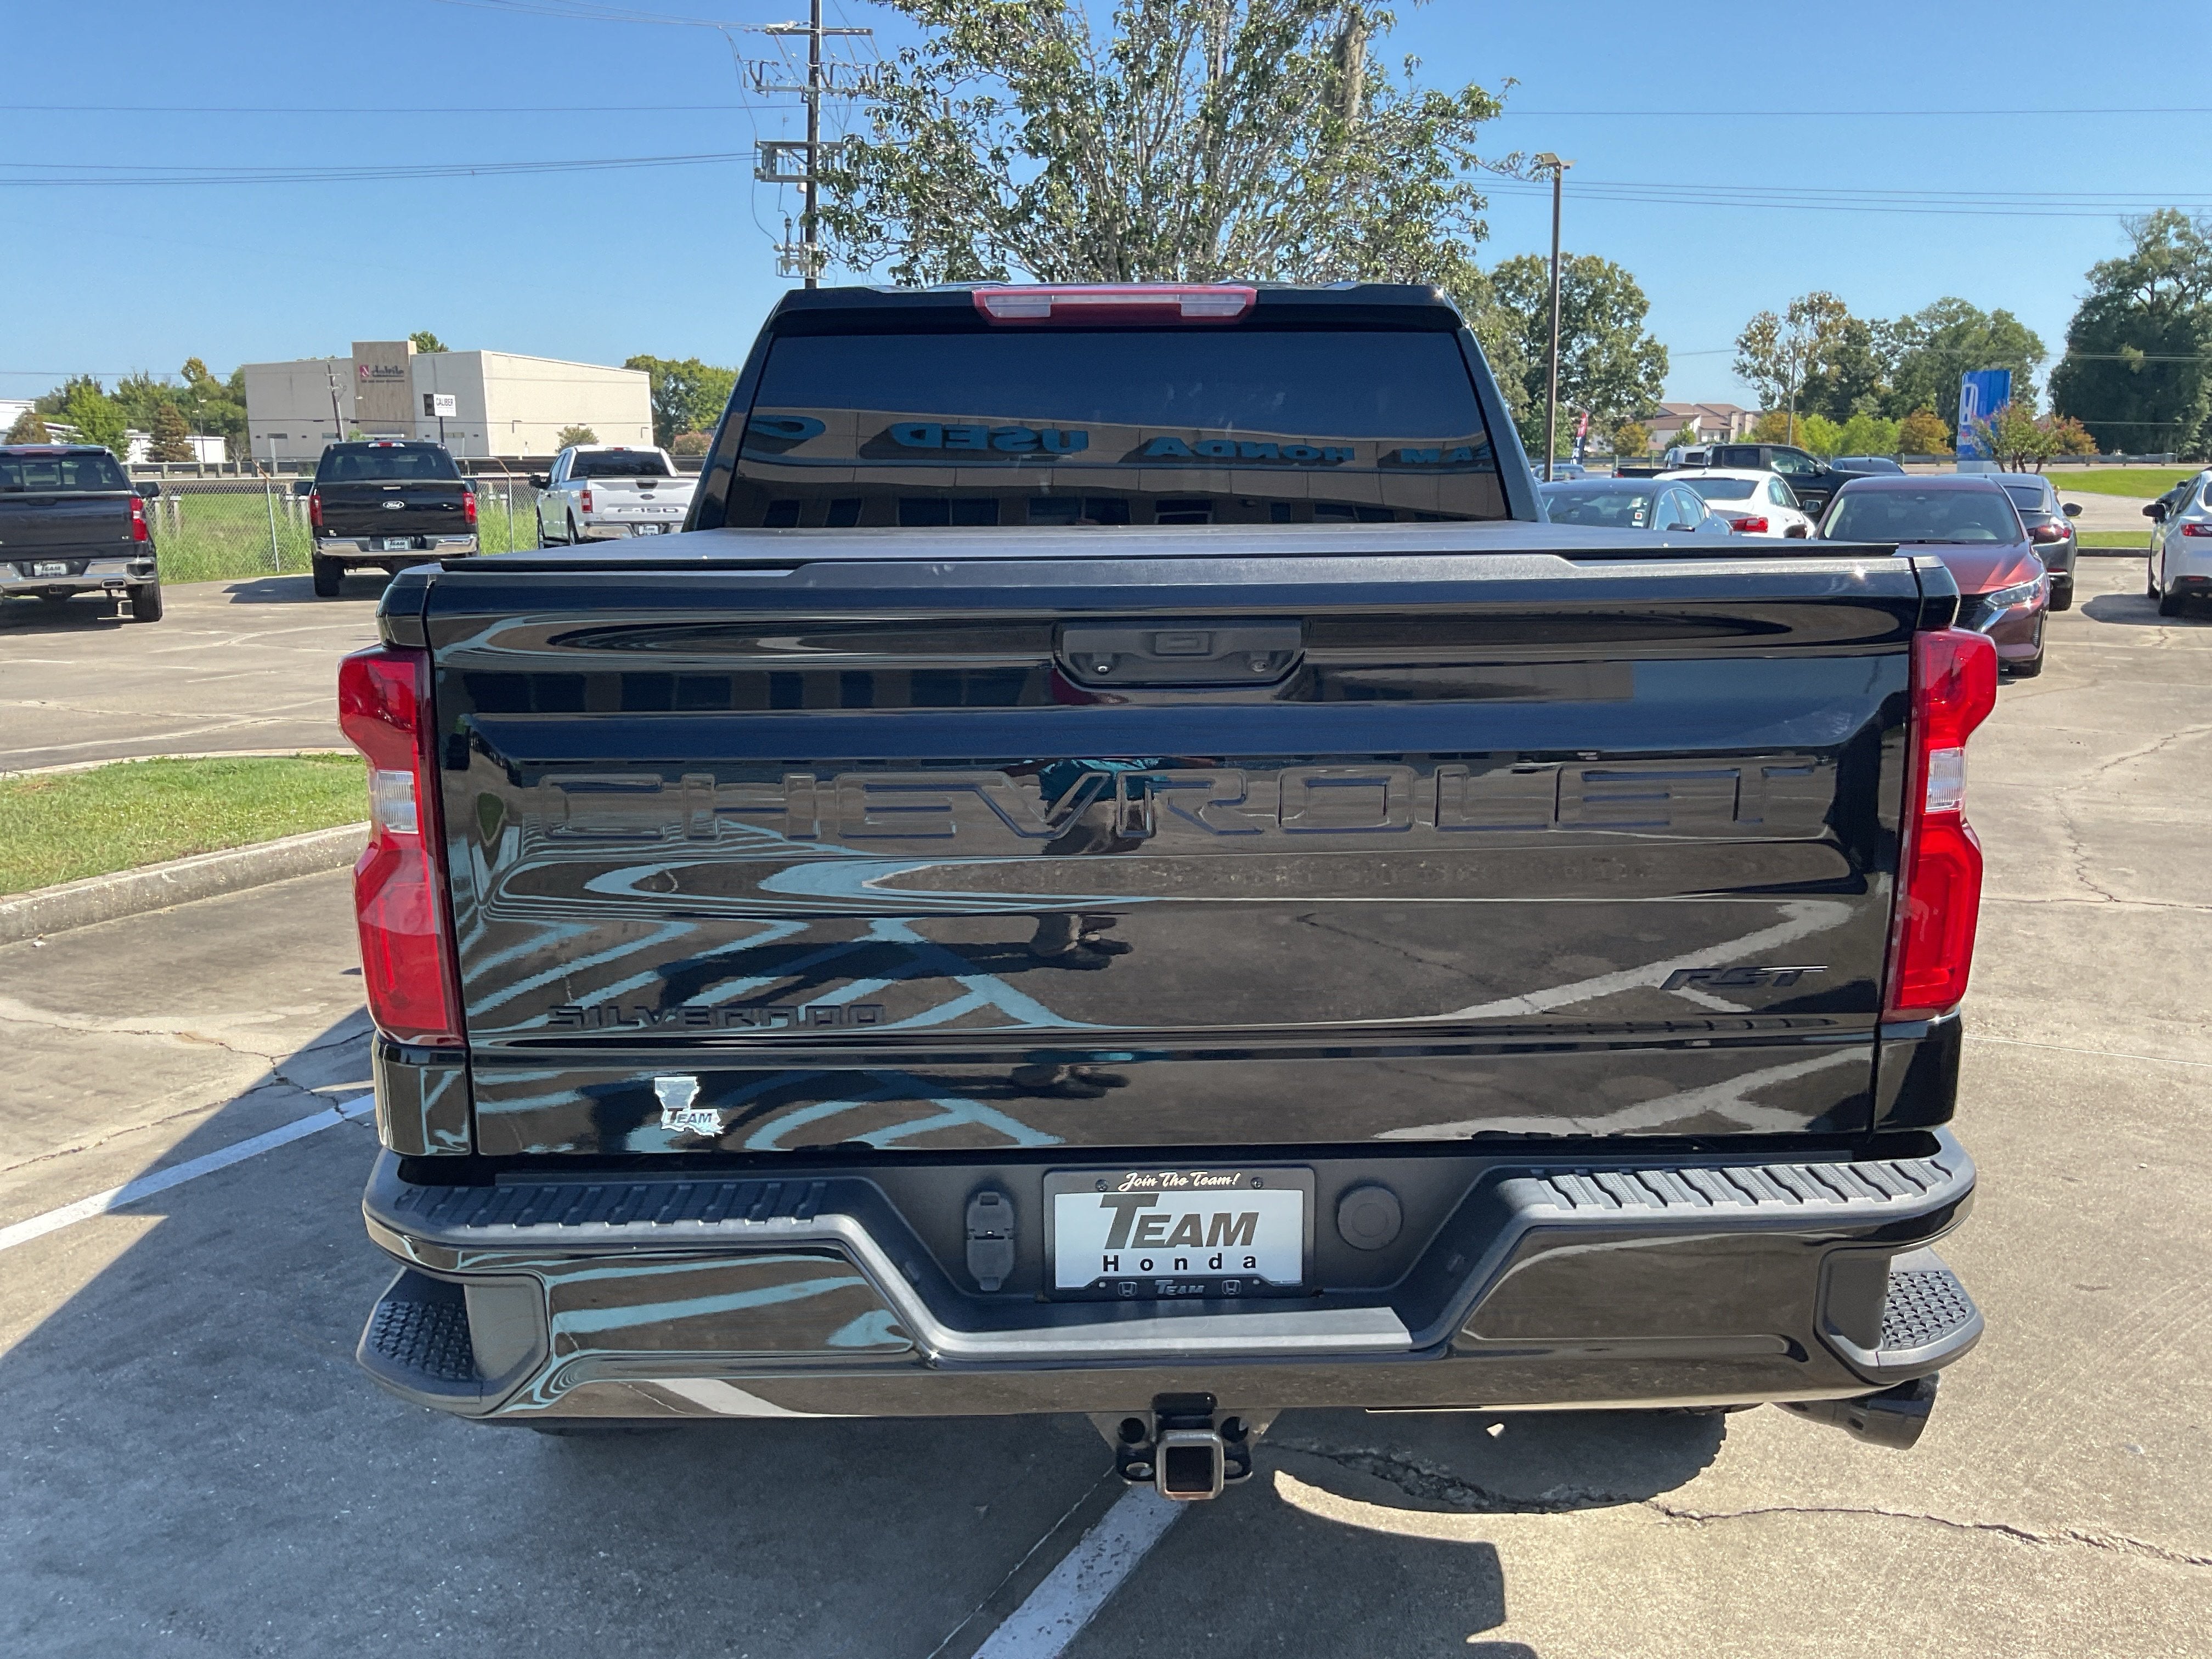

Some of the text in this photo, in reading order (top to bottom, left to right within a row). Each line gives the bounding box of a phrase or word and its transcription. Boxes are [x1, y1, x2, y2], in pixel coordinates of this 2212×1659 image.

[436, 398, 454, 407] CALIBER
[41, 563, 61, 572] TEAM
[538, 765, 1816, 843] CHEVROLET
[548, 1005, 886, 1027] SILVERADO
[667, 1108, 713, 1124] TEAM
[1118, 1171, 1242, 1192] Join The Team!
[1099, 1193, 1260, 1250] TEAM
[1103, 1252, 1256, 1272] Honda
[1154, 1279, 1205, 1296] TEAM
